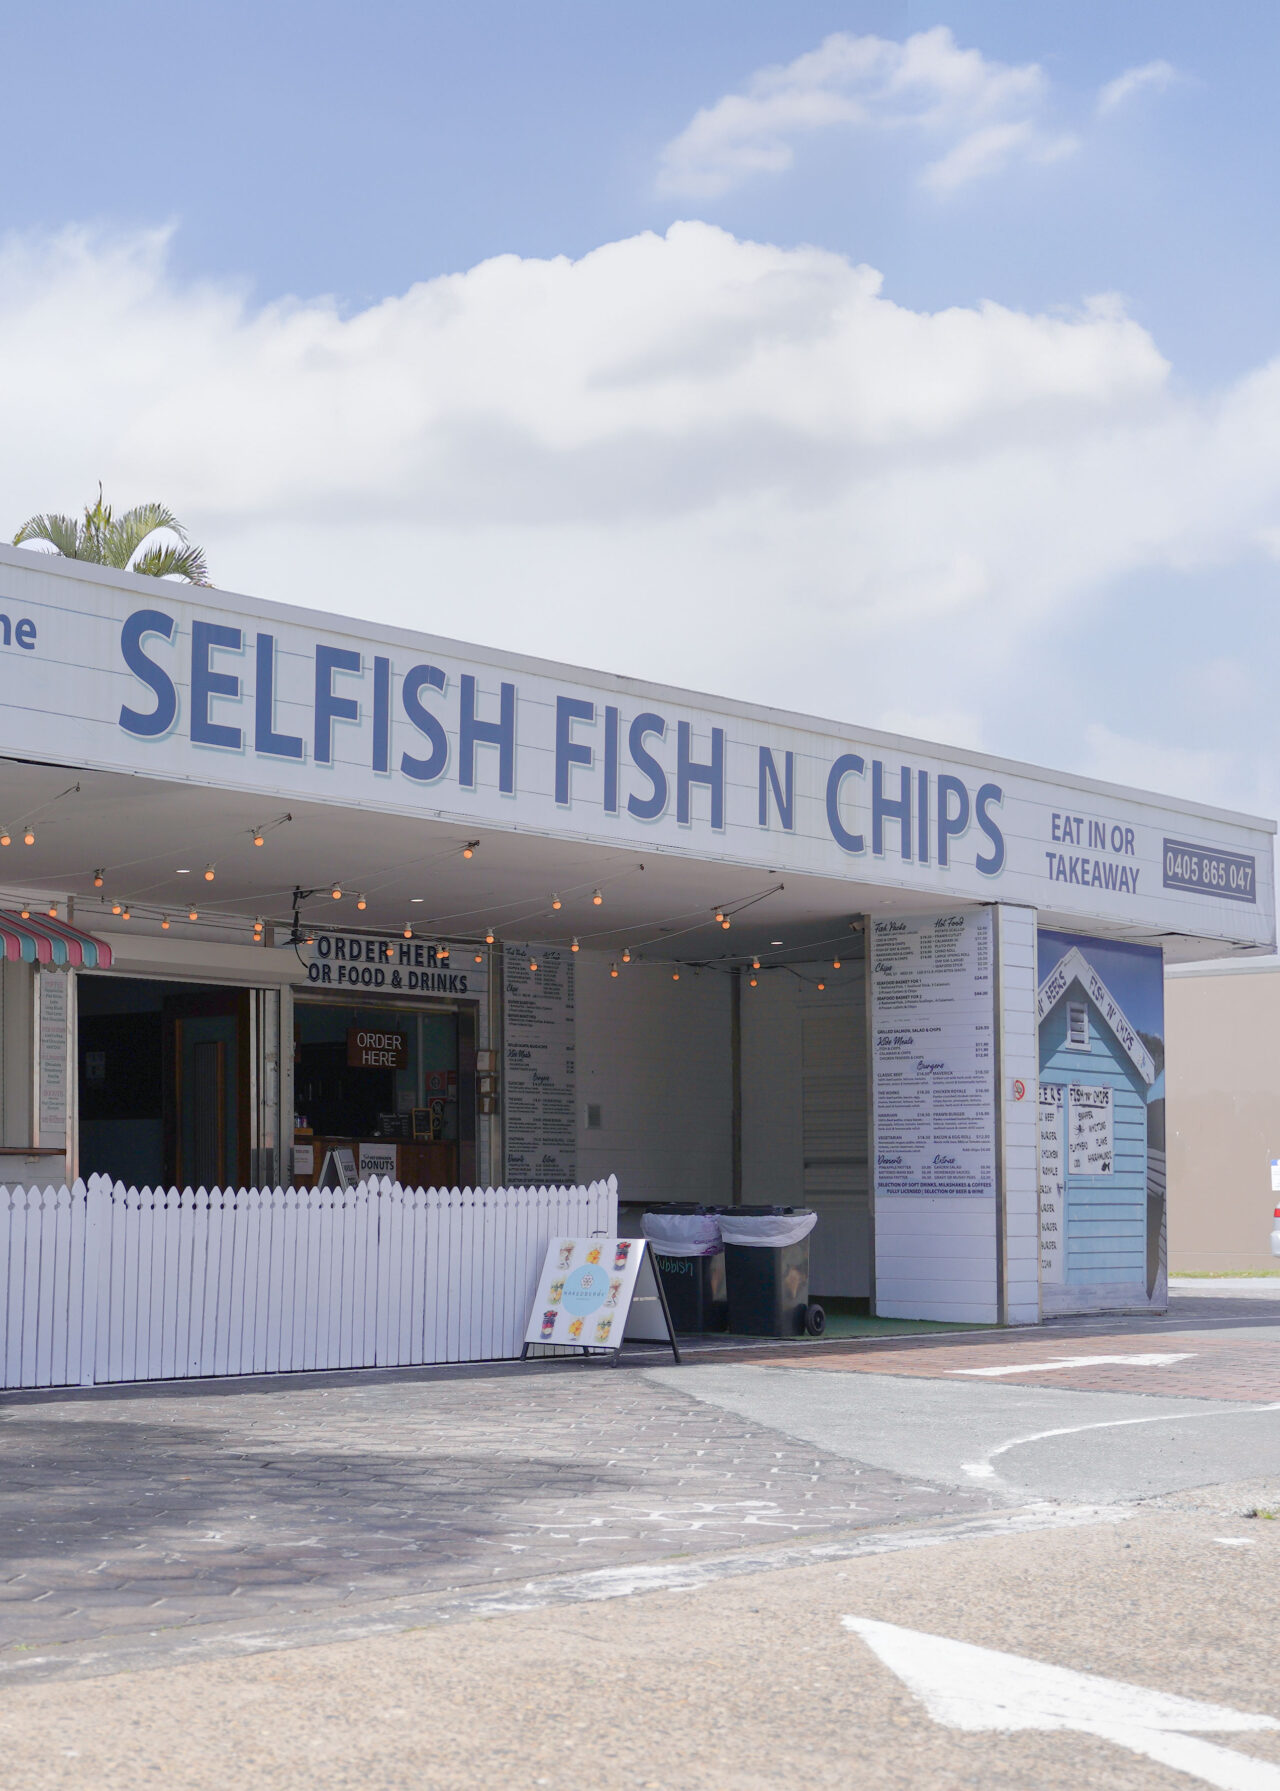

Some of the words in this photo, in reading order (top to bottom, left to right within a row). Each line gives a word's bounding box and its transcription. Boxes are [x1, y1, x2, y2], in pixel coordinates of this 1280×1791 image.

[118, 608, 517, 797] SELFISH
[554, 694, 725, 831] FISH
[758, 745, 794, 831] N
[826, 752, 1005, 877] CHIPS
[1051, 812, 1084, 845] EAT
[1088, 820, 1106, 850] IN
[1110, 825, 1135, 856] OR
[1045, 851, 1140, 895] TAKEAWAY
[1166, 852, 1199, 882] 0405
[1202, 859, 1226, 887] 865
[1229, 864, 1253, 891] 047
[948, 916, 964, 928] Food
[318, 935, 391, 964] ORDER
[399, 942, 451, 969] HERE
[308, 962, 332, 984] OR
[338, 965, 385, 988] FOOD
[391, 969, 403, 989] &
[408, 971, 468, 995] DRINKS
[1089, 975, 1105, 1007] FISH
[1116, 1018, 1134, 1051] CHIPS
[357, 1032, 402, 1050] ORDER
[362, 1050, 397, 1067] HERE
[917, 1060, 944, 1073] Burgers
[1039, 1087, 1061, 1102] ERS
[1070, 1088, 1083, 1102] FISH
[361, 1160, 395, 1171] DONUTS
